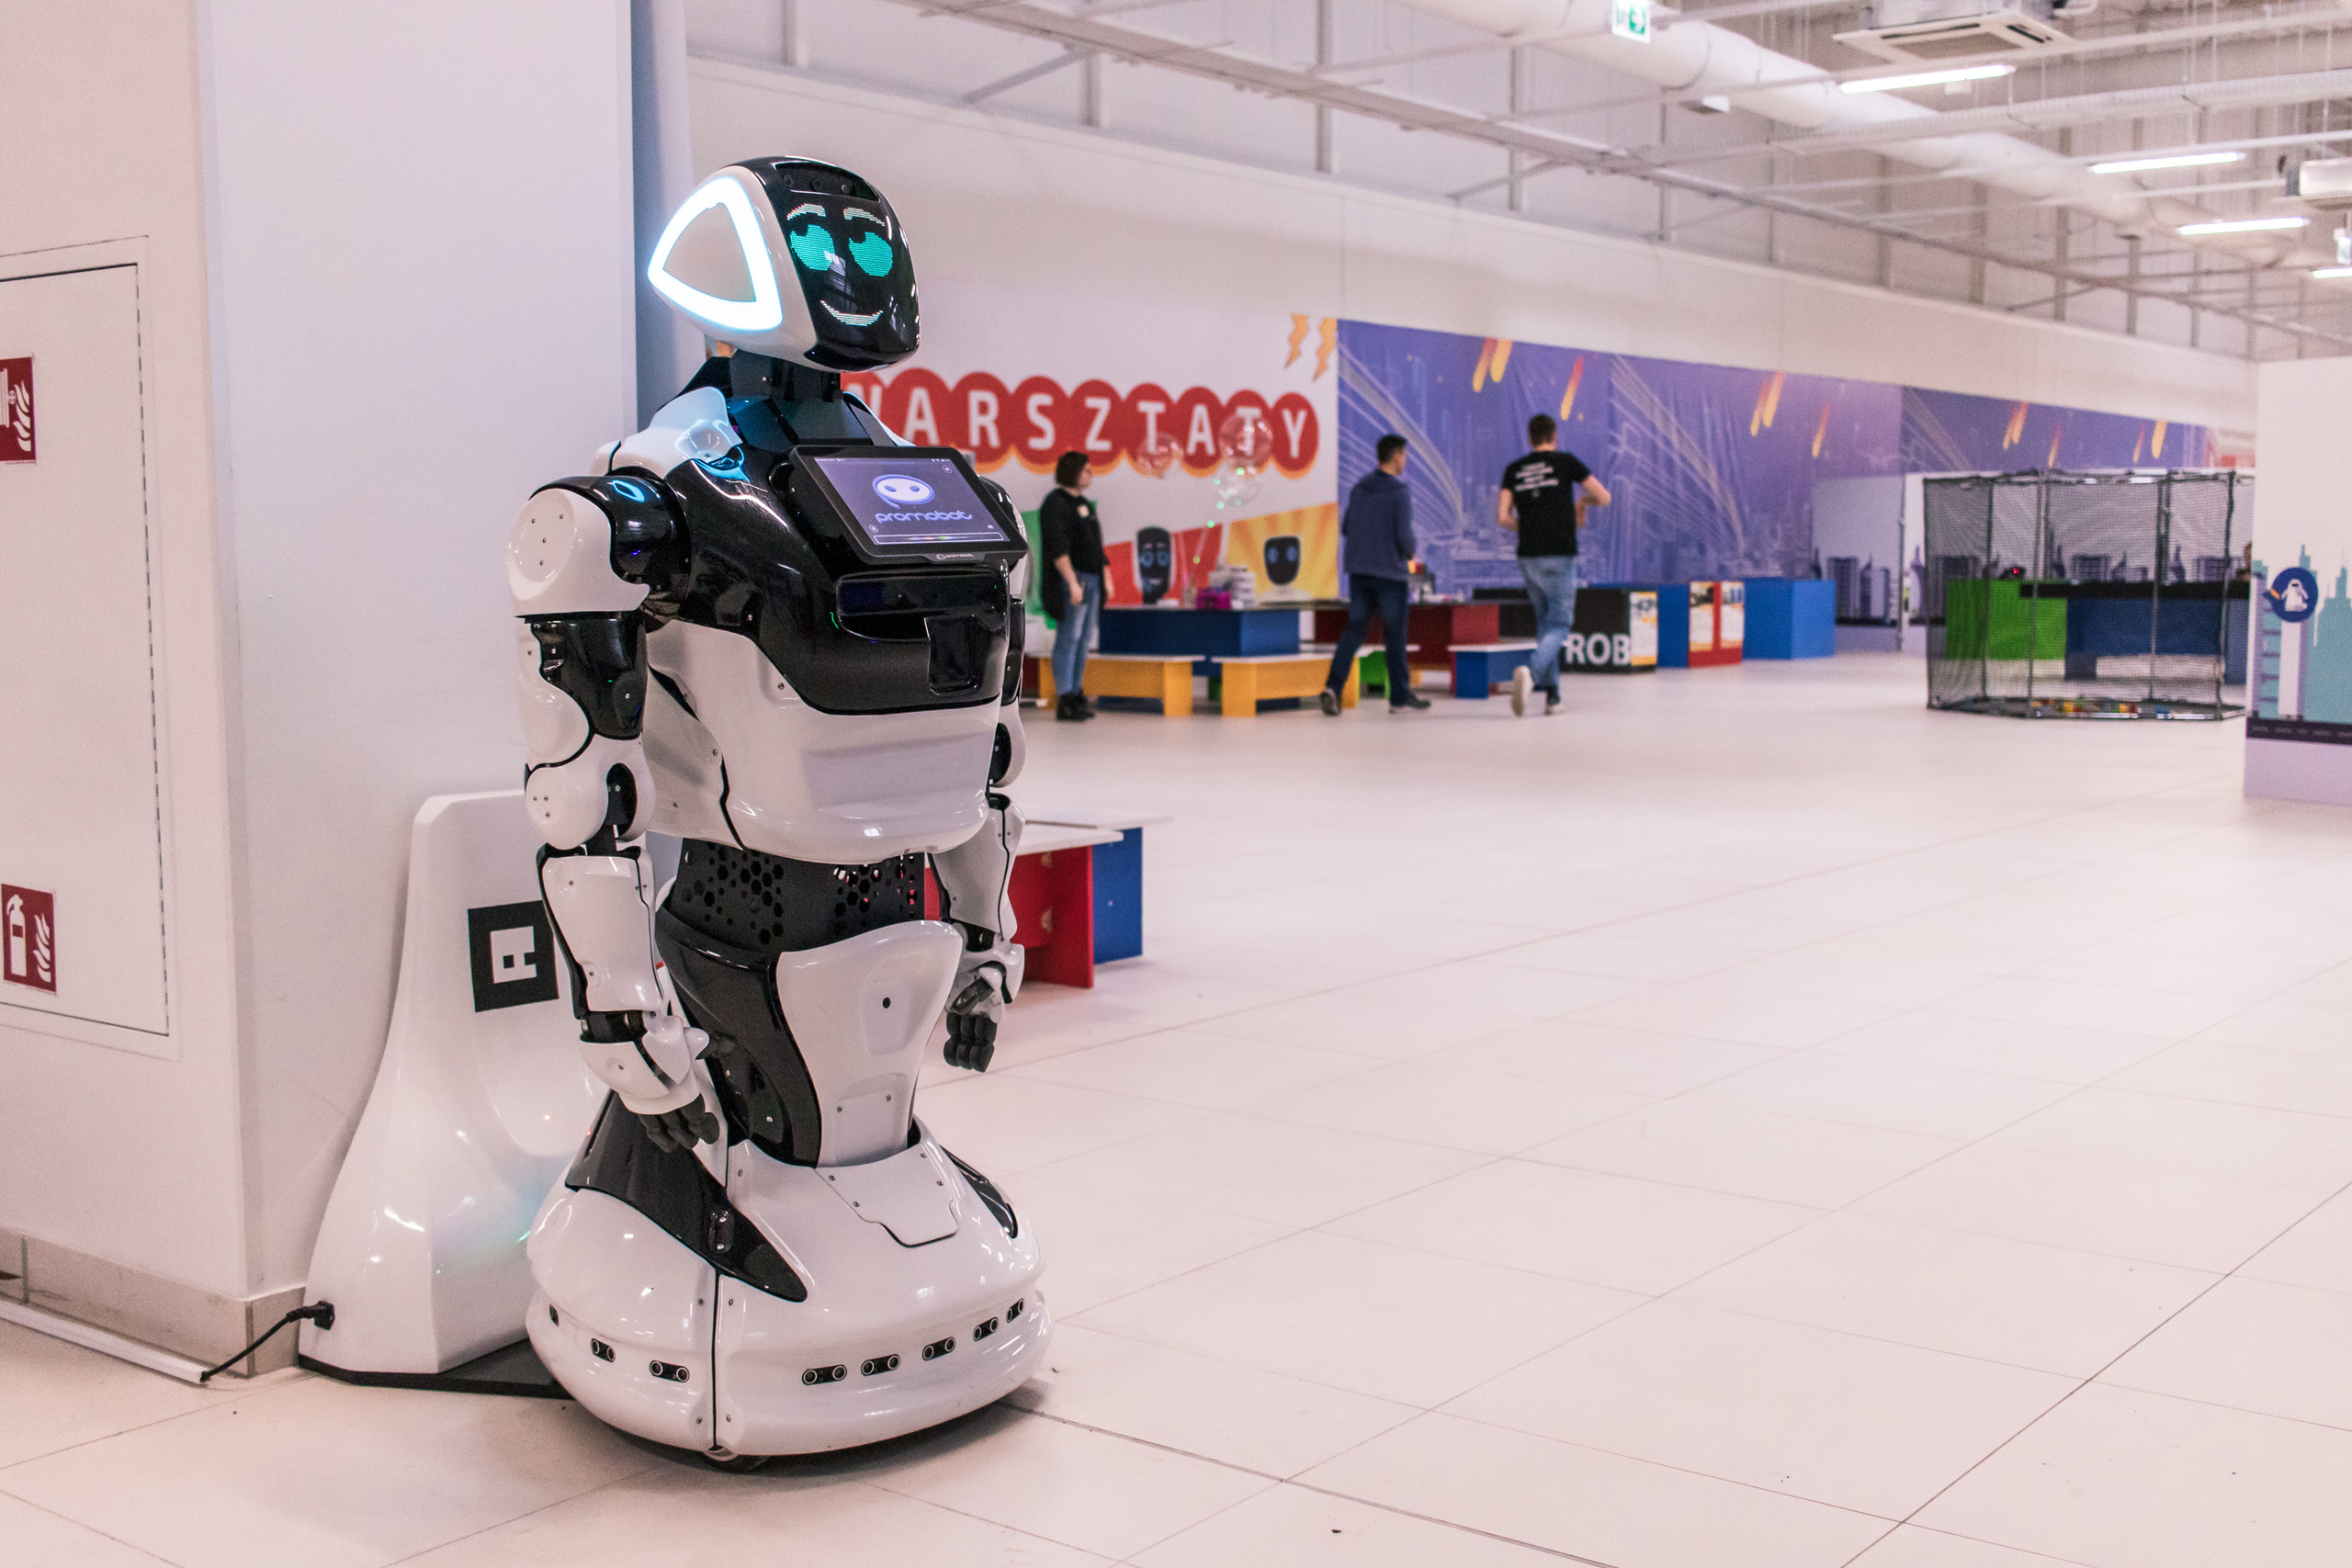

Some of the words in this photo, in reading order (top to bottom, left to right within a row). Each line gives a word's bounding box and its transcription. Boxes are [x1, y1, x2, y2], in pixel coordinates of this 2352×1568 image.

[847, 384, 1307, 458] ARSZTATY
[876, 510, 973, 524] promobot
[1566, 633, 1631, 665] ROB
